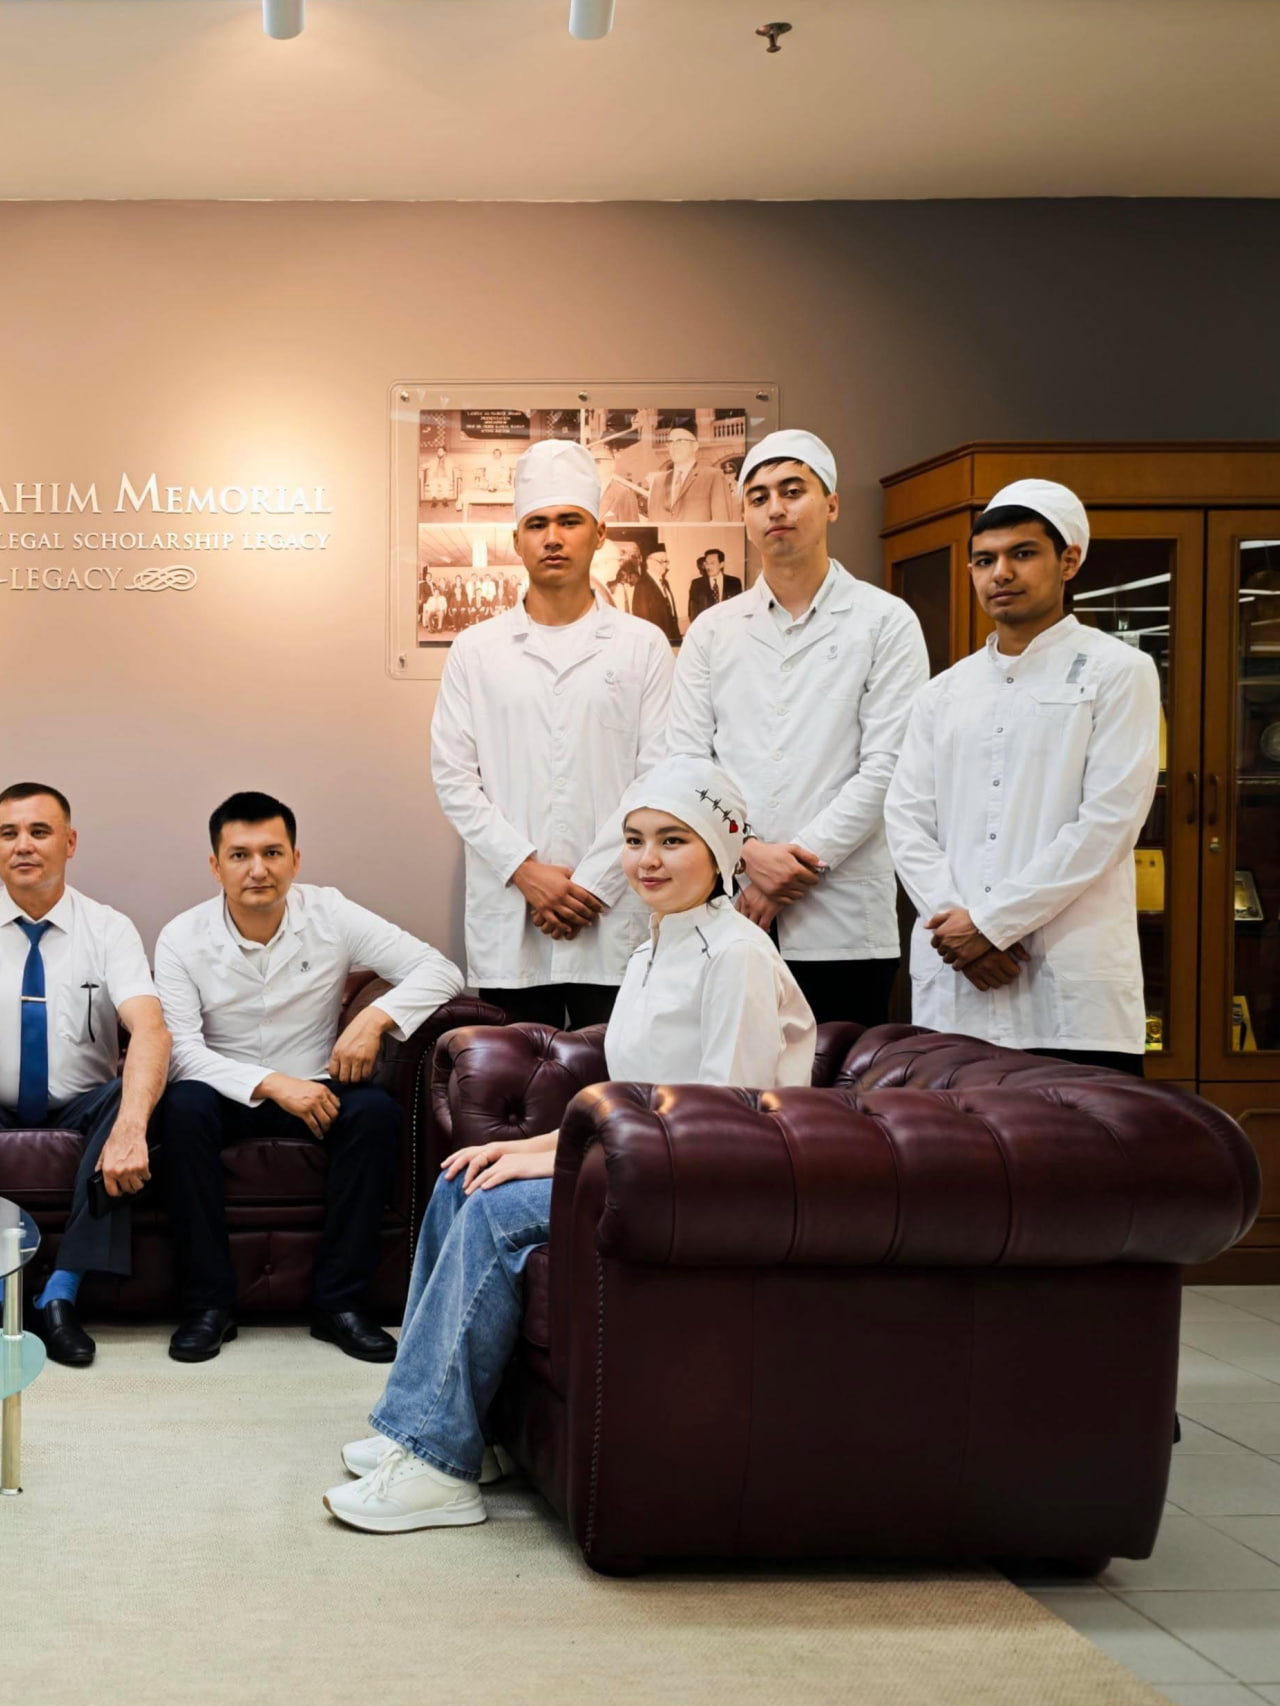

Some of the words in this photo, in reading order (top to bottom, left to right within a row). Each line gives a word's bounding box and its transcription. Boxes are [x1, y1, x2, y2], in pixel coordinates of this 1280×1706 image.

[112, 471, 334, 515] MEMORIAL
[72, 532, 234, 551] SCHOLARSHIP
[242, 532, 331, 551] LEGACY
